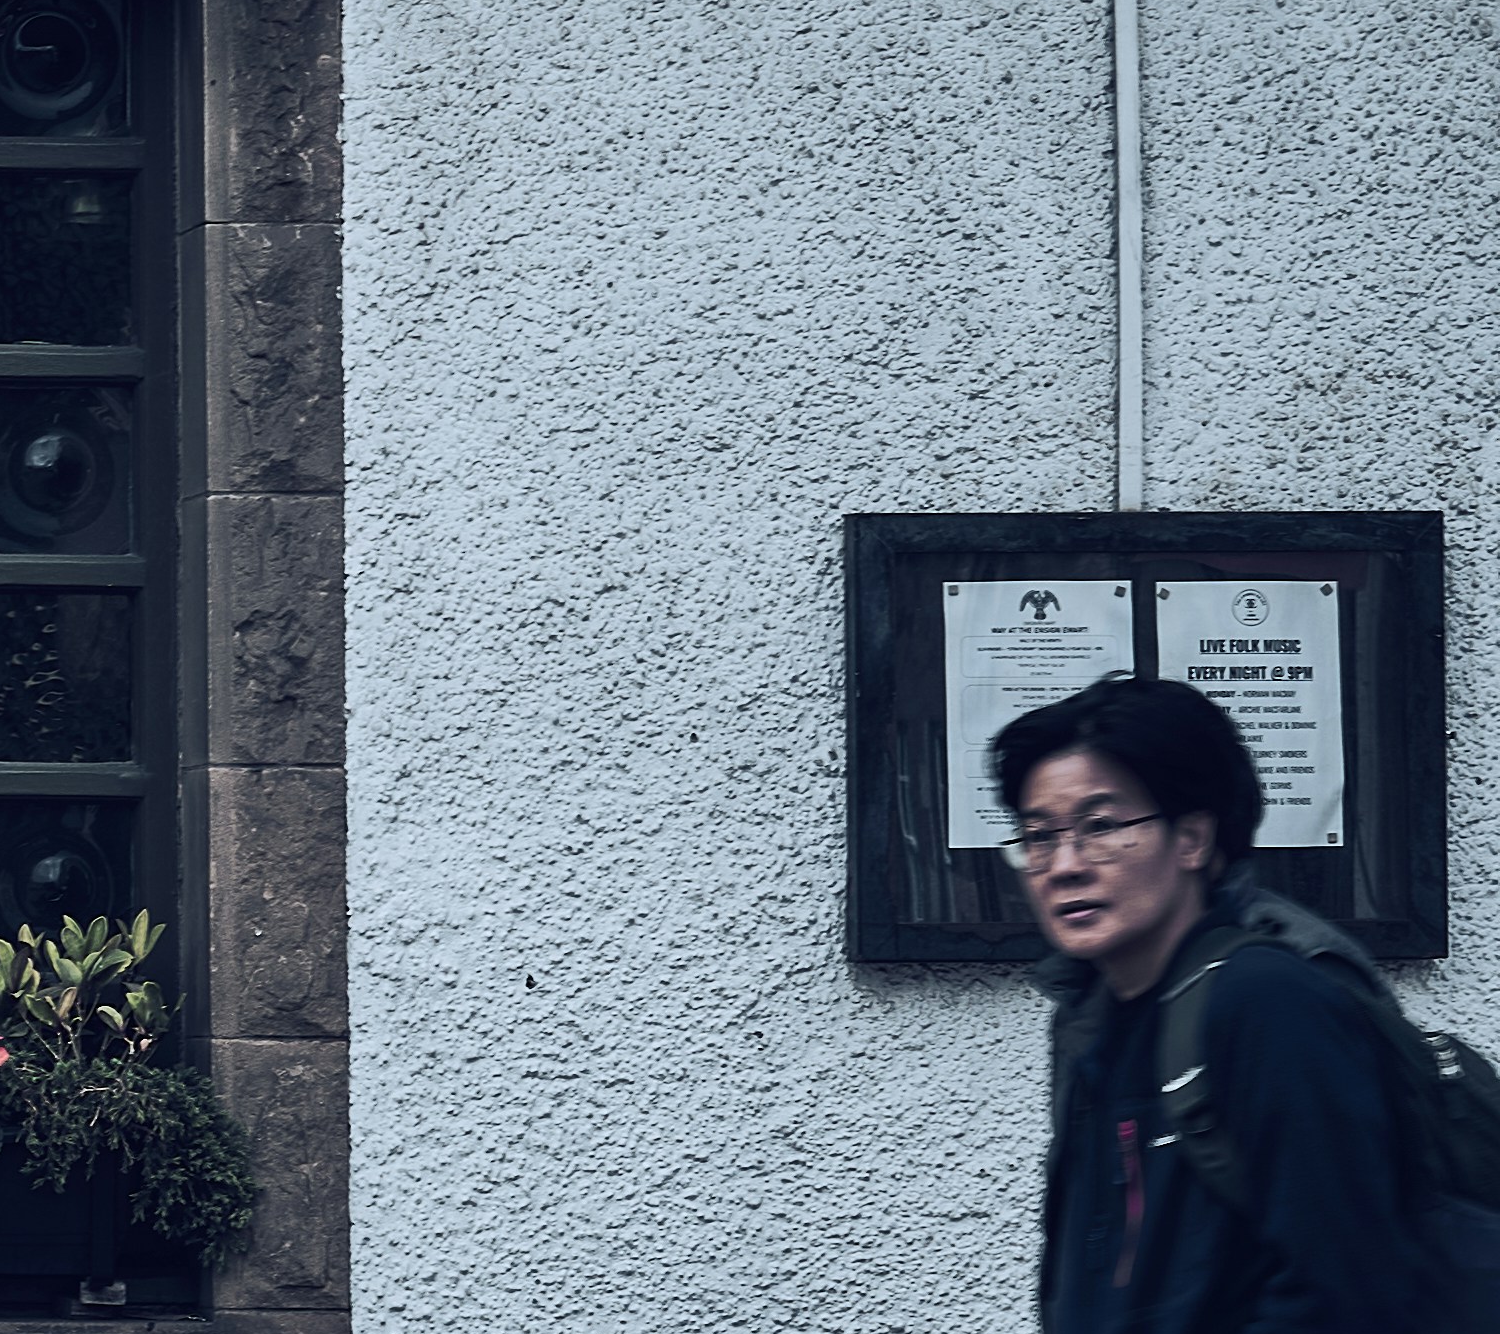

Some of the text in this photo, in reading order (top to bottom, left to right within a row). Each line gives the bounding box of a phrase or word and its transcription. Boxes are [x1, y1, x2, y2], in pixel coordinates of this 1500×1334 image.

[1199, 639, 1302, 653] LIVE FOLK MUSIC
[1187, 666, 1314, 681] EVERY NIGHT @ 9PM
